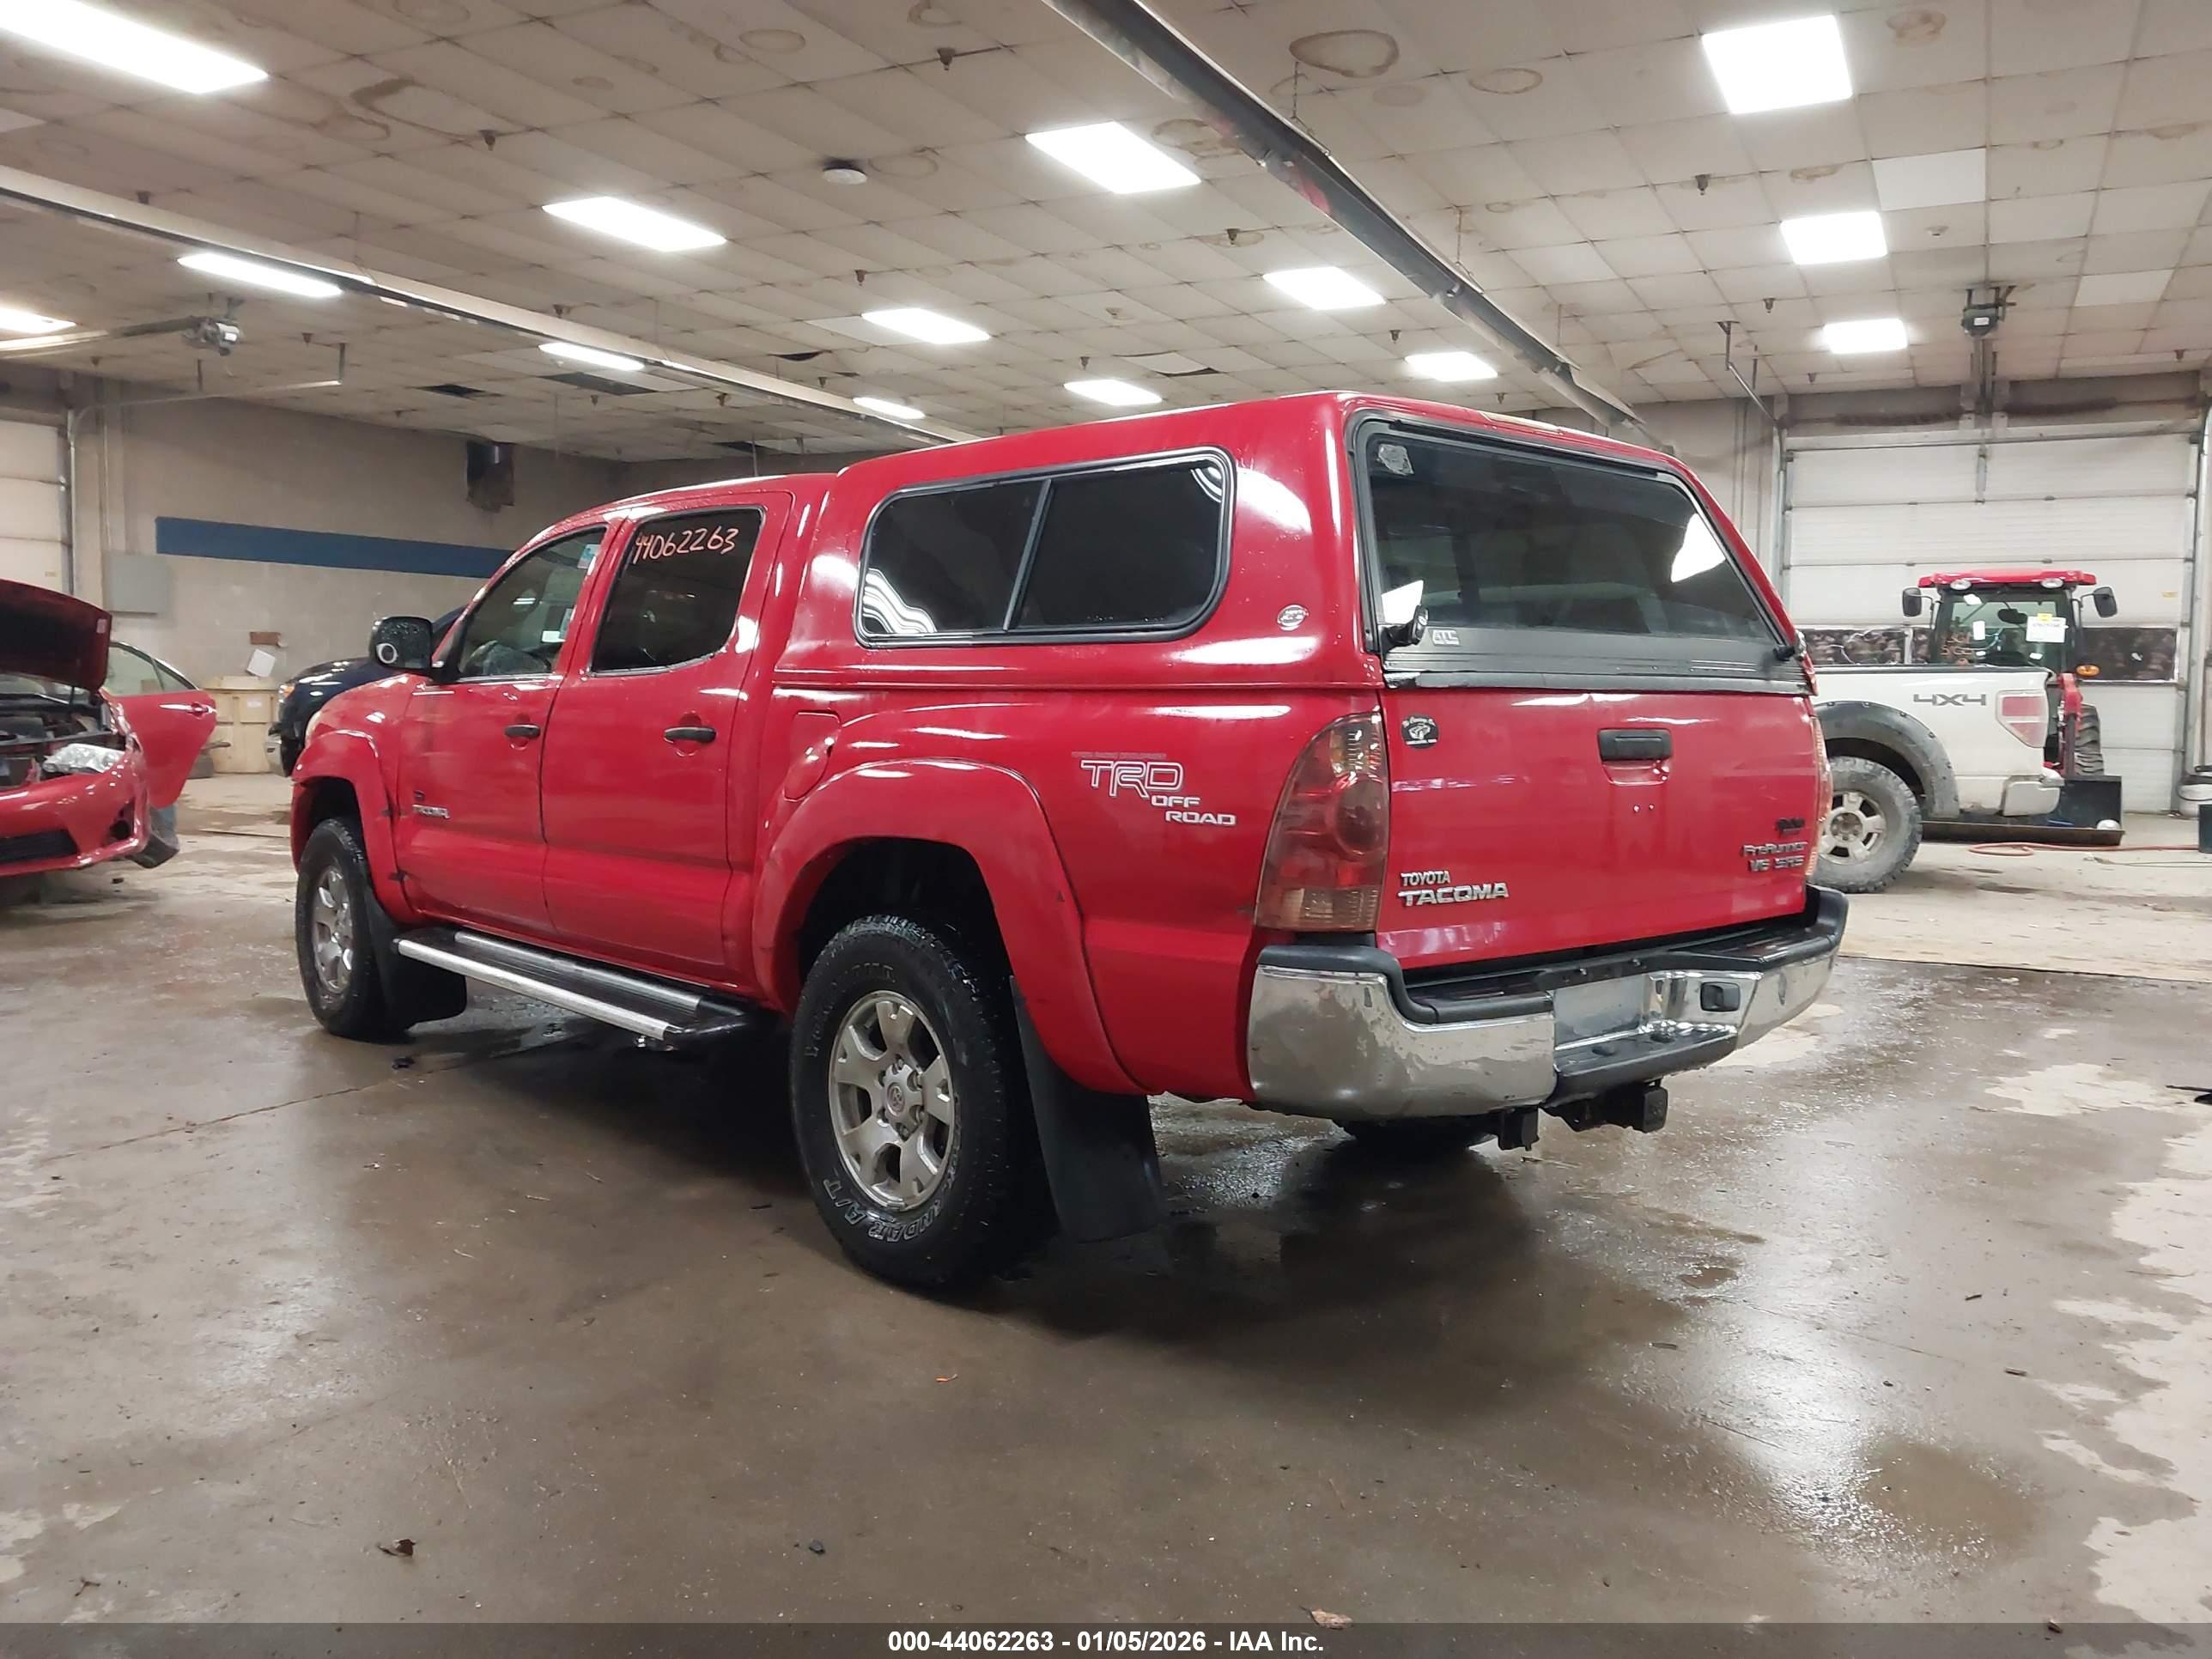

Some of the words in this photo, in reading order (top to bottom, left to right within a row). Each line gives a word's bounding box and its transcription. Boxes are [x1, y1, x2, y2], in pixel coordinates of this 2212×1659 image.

[633, 526, 739, 564] 44062263
[1913, 694, 1987, 707] 4X4
[1080, 760, 1183, 798] TRD
[1151, 795, 1200, 808] OFF
[1165, 811, 1237, 825] ROAD
[1401, 871, 1451, 886] TOYOTA
[1398, 883, 1509, 907] TACOMA
